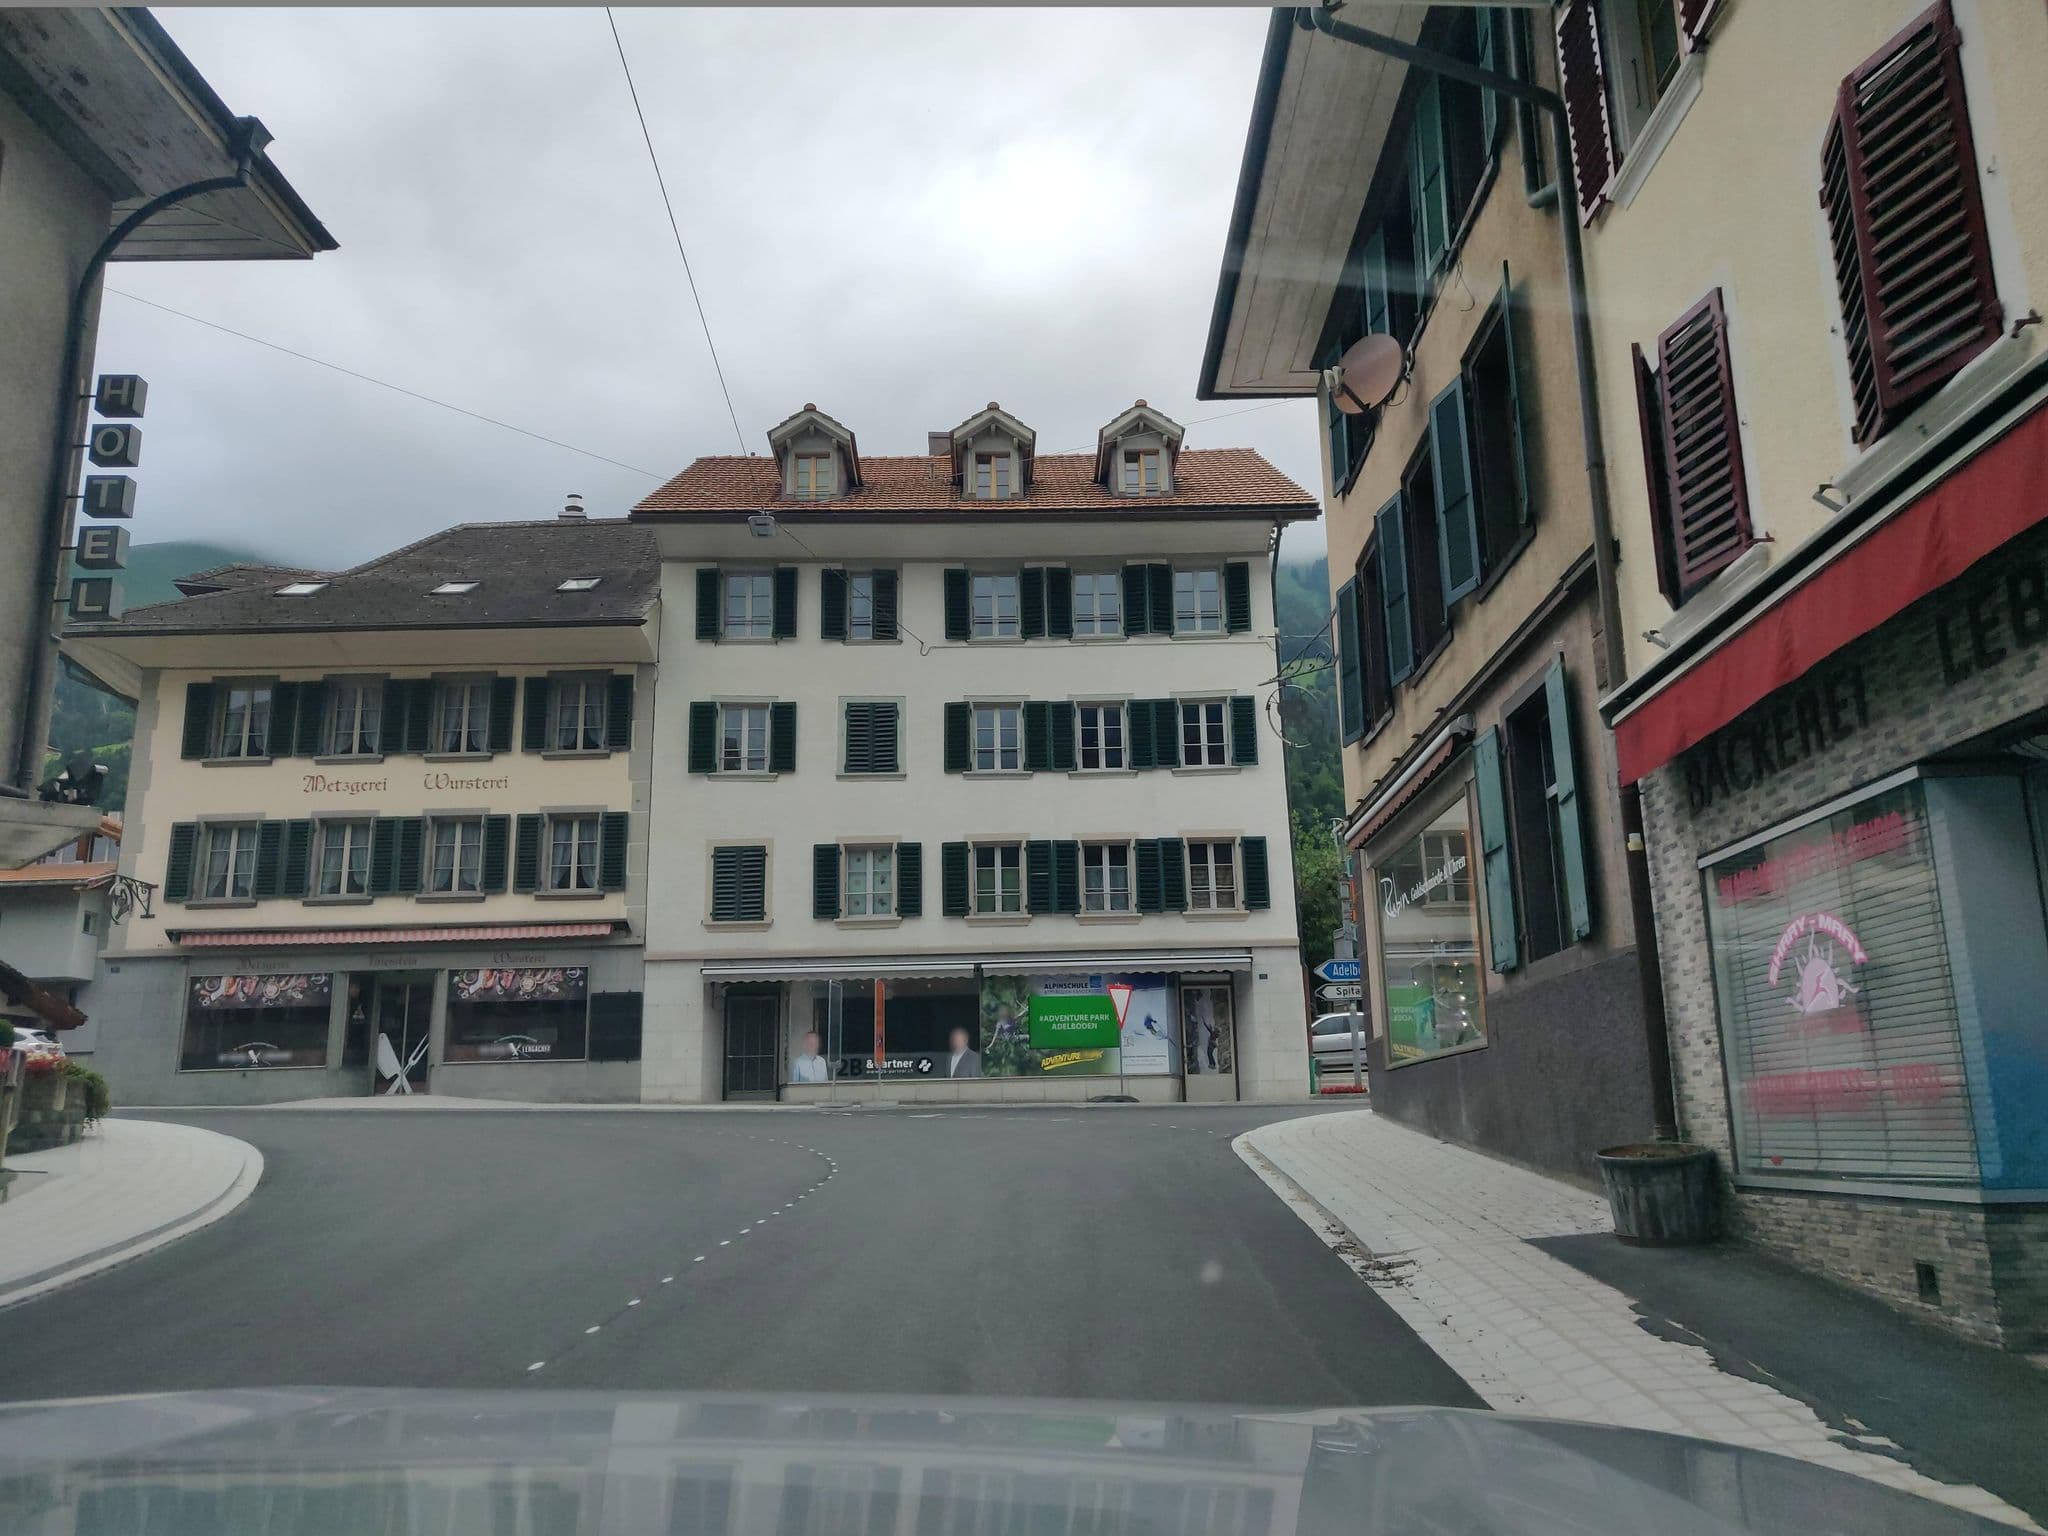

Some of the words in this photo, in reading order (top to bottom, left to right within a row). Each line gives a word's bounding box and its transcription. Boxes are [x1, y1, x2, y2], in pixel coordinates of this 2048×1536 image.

[76, 377, 131, 613] HOTEL
[302, 774, 387, 795] Metzgerei
[423, 773, 508, 790] Wursterei
[1044, 982, 1089, 990] ALPINSCHULE
[1039, 1014, 1089, 1022] #ADVENTURE
[1090, 1013, 1110, 1021] PARK
